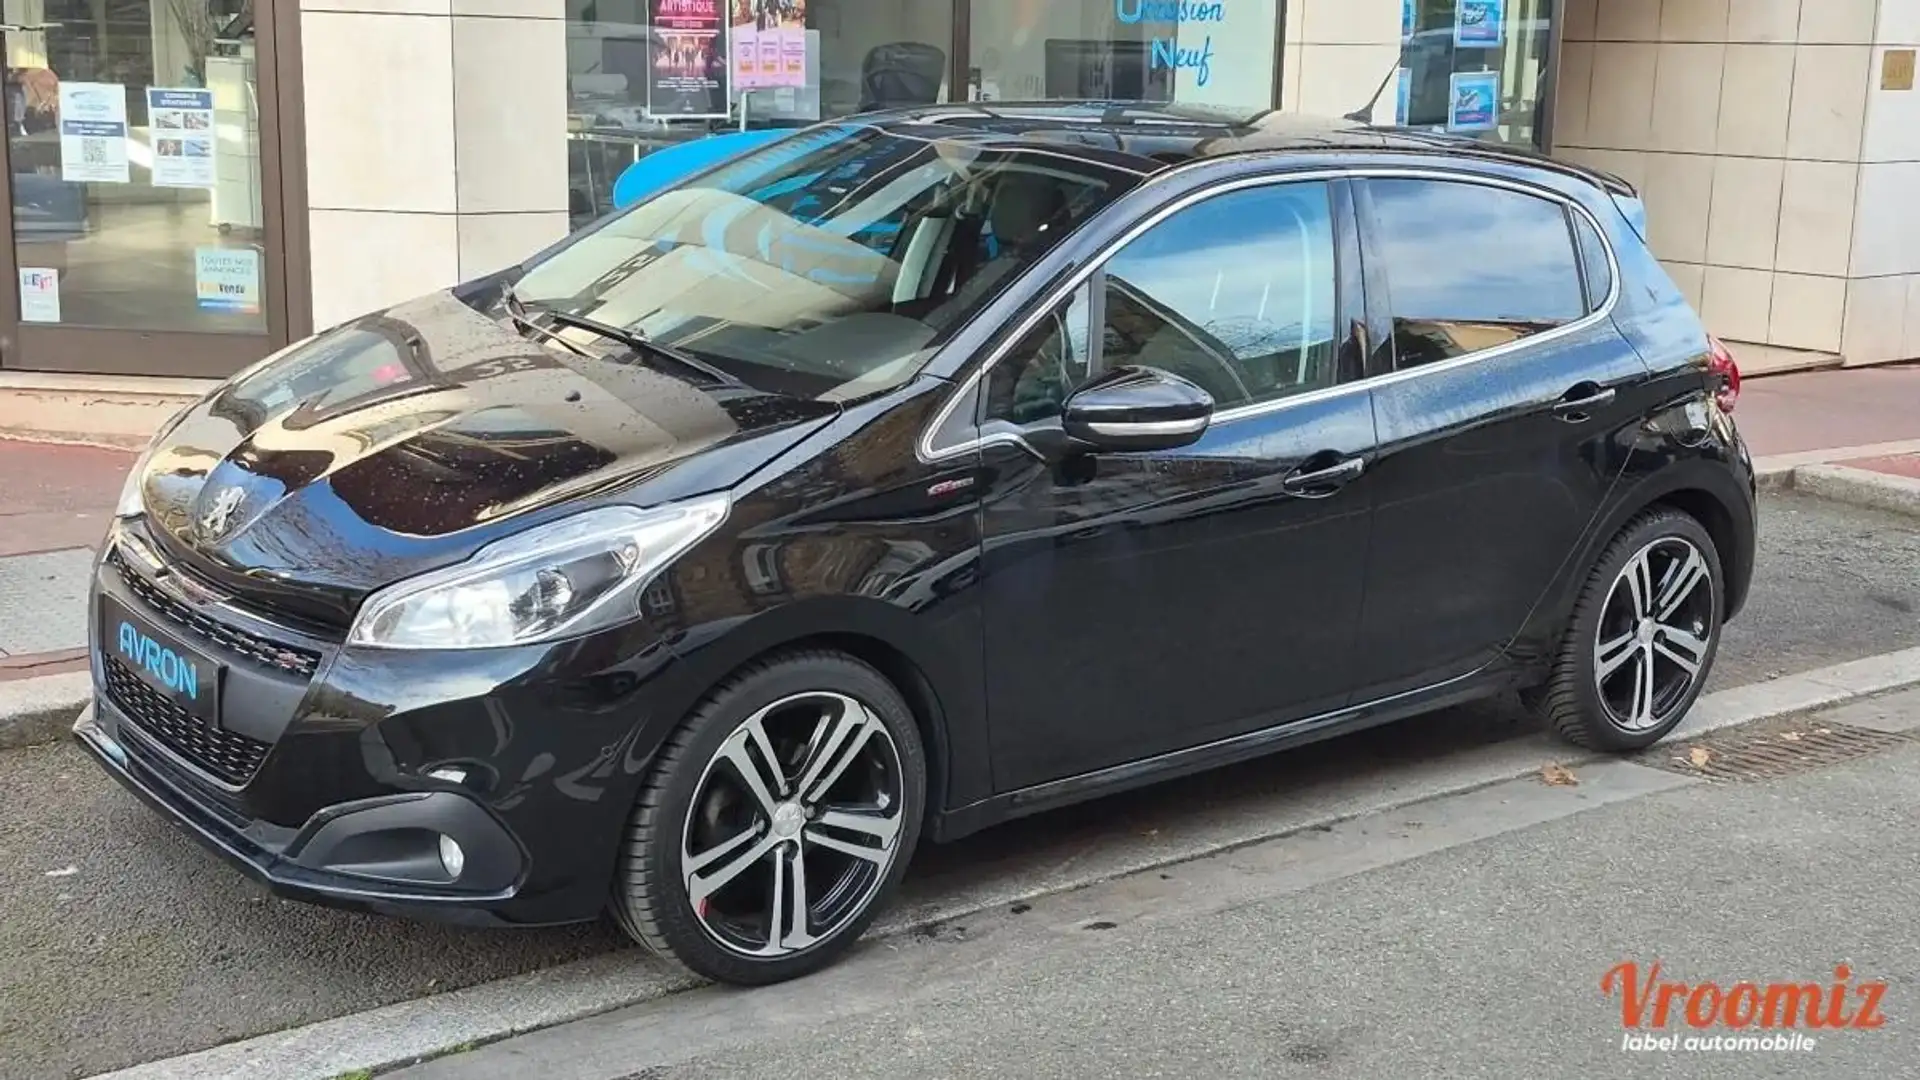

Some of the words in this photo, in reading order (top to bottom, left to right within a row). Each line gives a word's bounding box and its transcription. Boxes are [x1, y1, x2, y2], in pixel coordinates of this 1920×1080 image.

[660, 0, 717, 13] ARTISTIQUE
[1151, 36, 1214, 87] Neuf
[119, 621, 197, 700] AVRON
